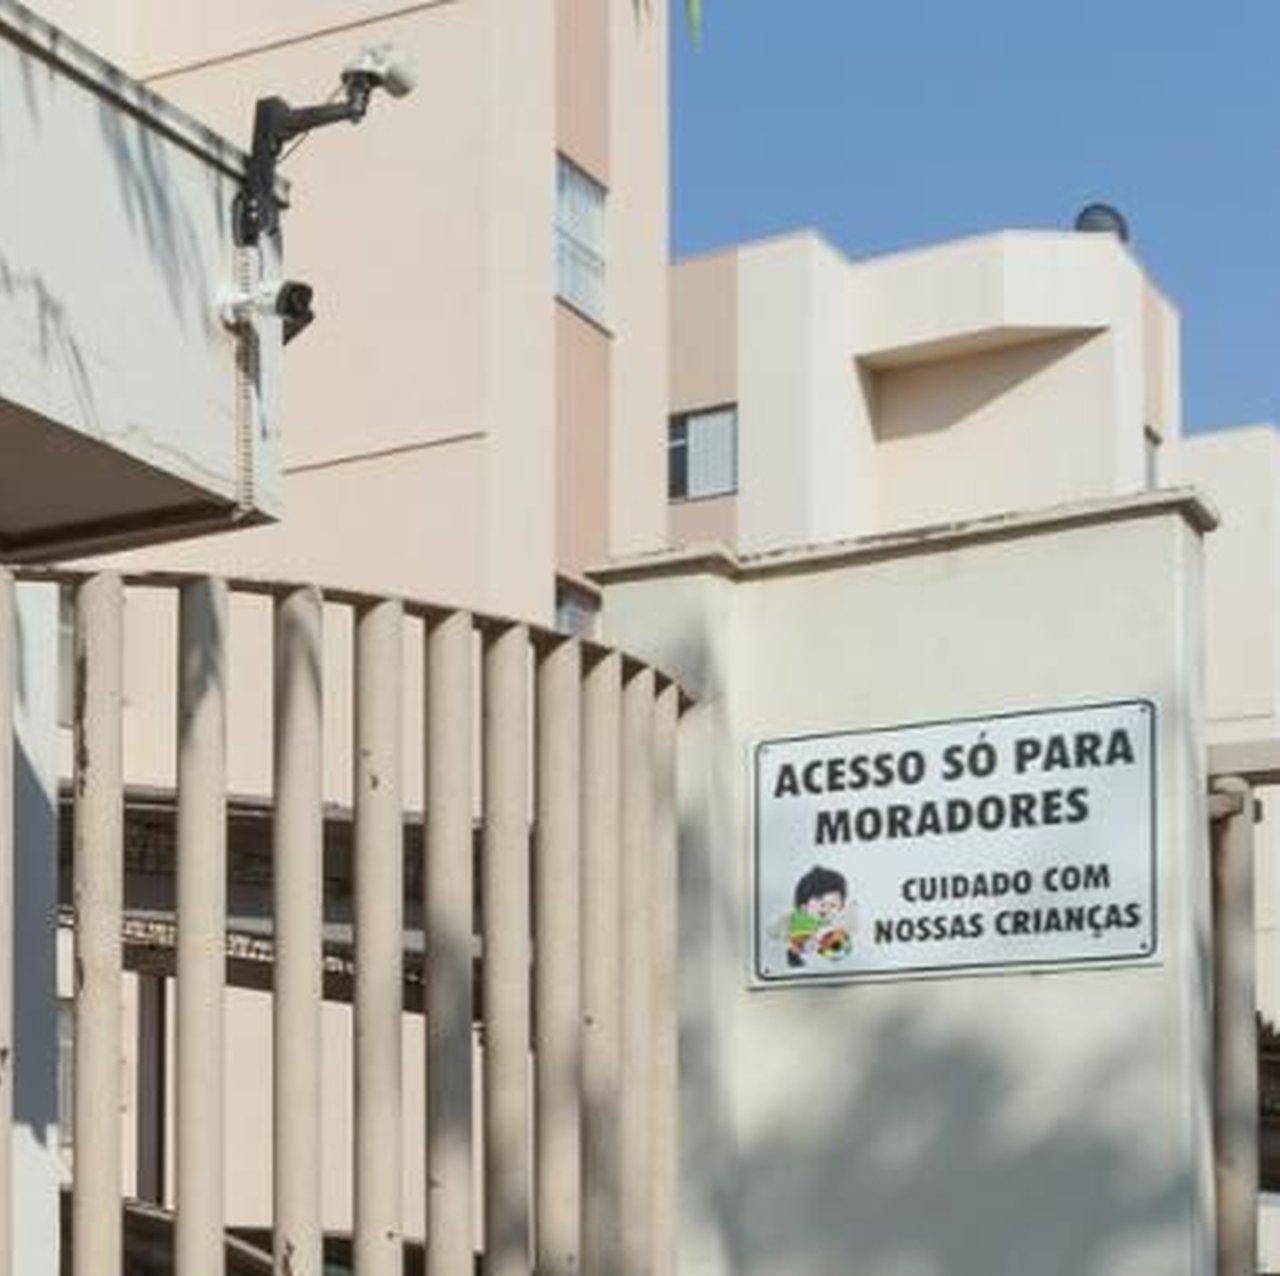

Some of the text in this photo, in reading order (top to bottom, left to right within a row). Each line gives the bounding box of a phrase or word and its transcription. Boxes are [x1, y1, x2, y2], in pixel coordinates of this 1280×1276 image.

[774, 728, 1135, 798] ACESSO SÓ PARA
[814, 787, 1090, 845] MORADORES
[901, 863, 1111, 902] CUIDADO COM
[874, 903, 1141, 944] NOSSAS CRIANÇAS
